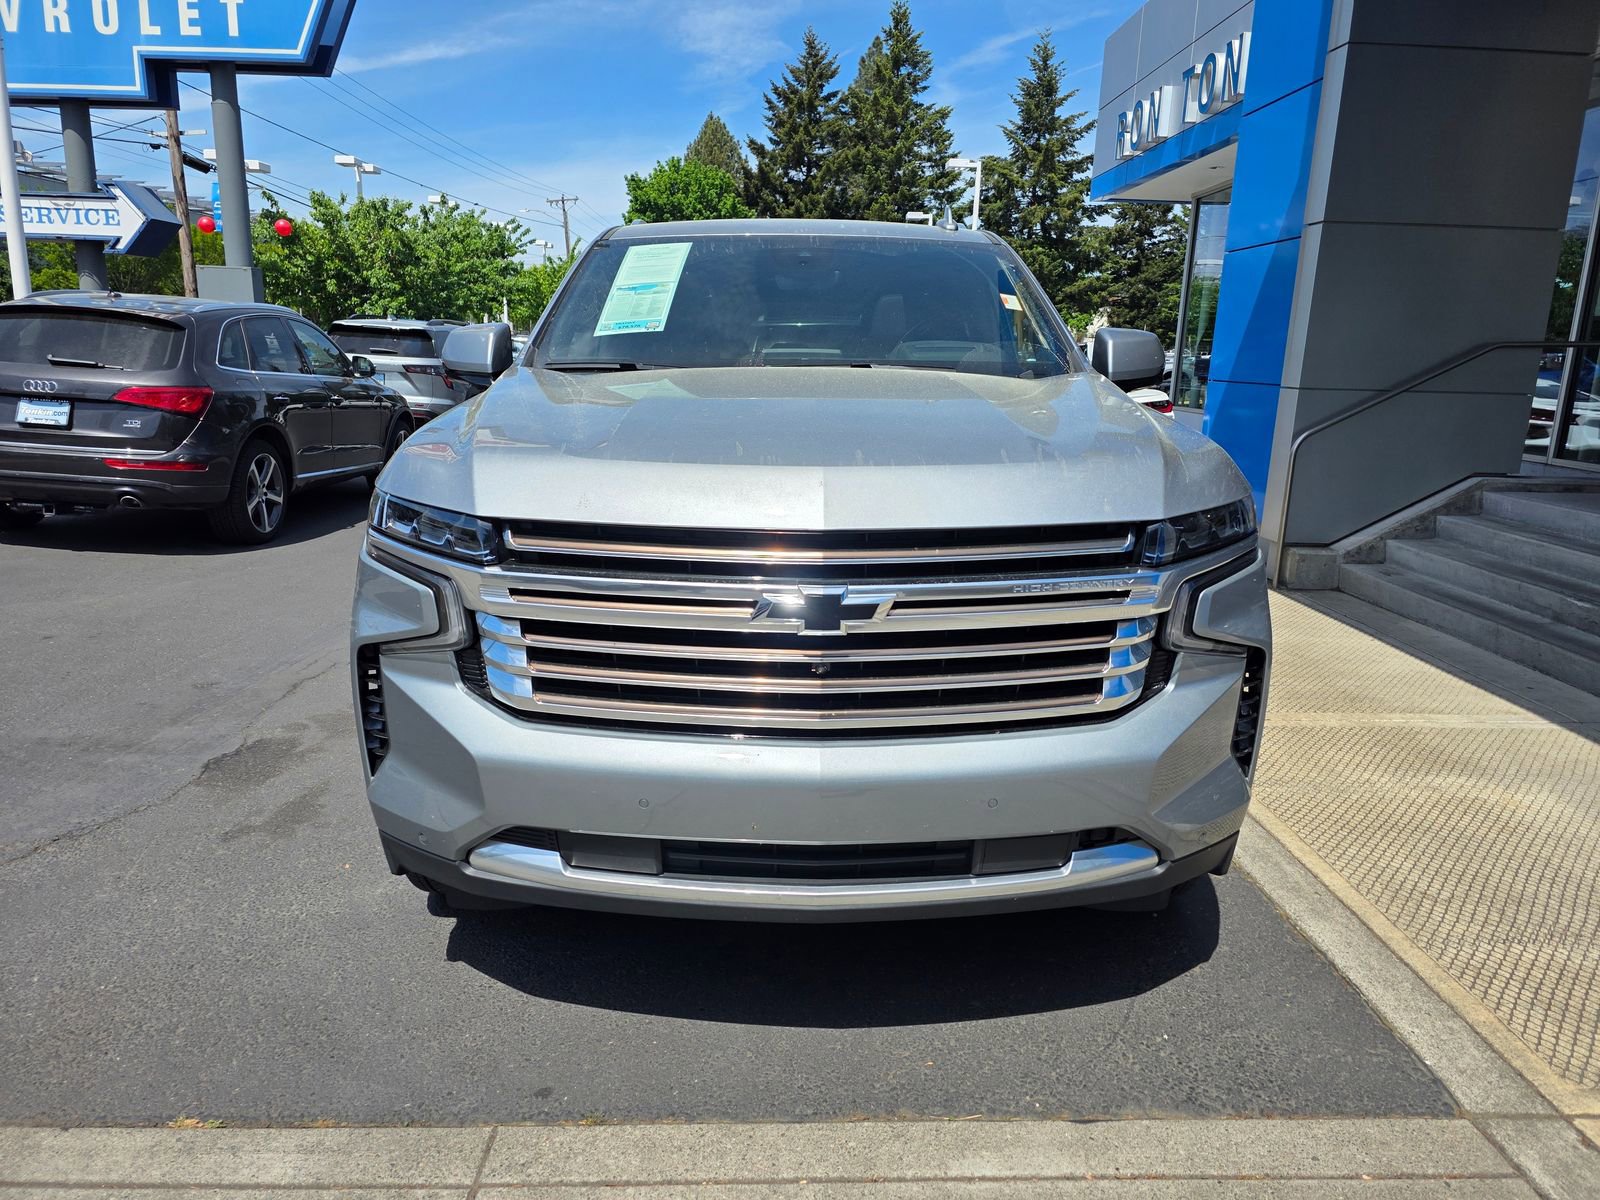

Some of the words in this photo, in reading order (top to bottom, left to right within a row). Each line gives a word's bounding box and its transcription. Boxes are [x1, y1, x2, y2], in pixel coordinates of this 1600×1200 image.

[1115, 84, 1174, 160] RON
[1013, 584, 1053, 593] HIGH
[1057, 578, 1135, 591] COUNTRY
